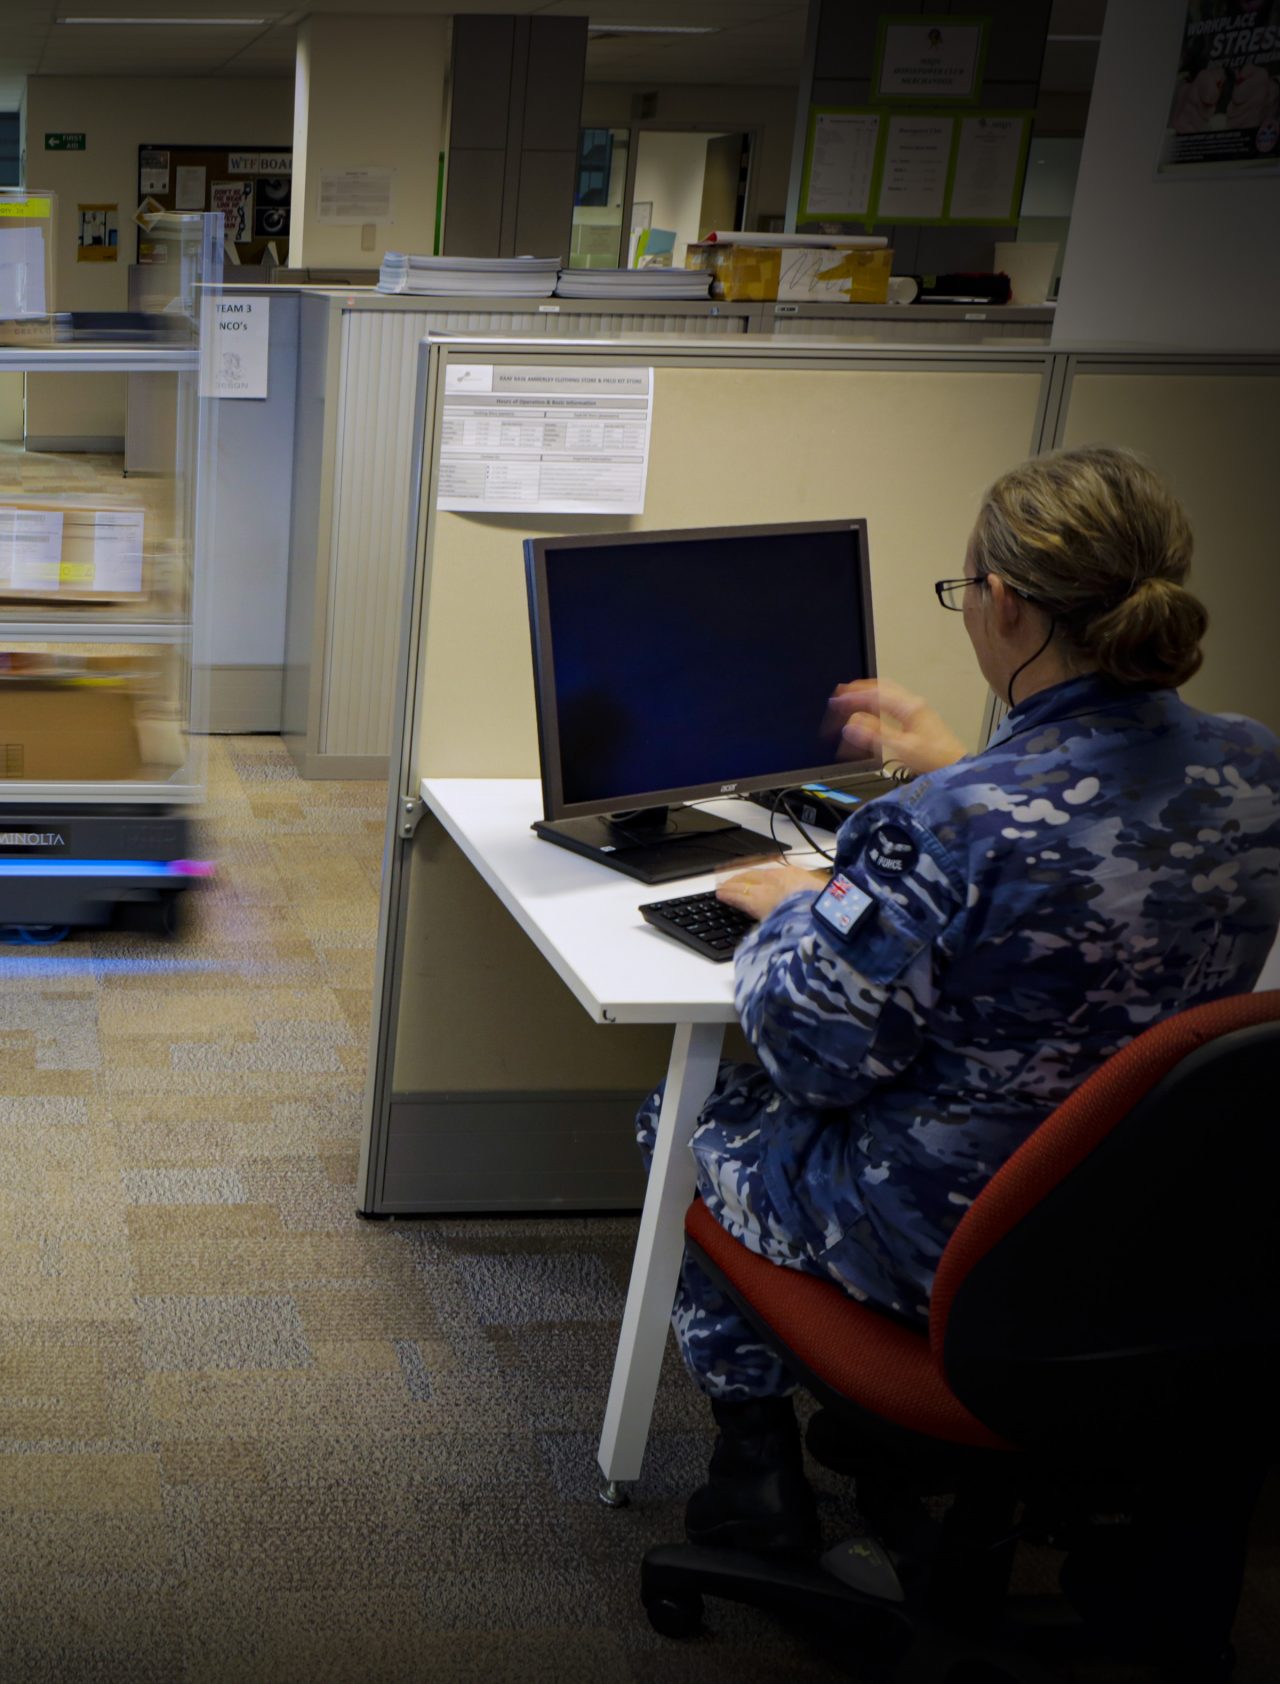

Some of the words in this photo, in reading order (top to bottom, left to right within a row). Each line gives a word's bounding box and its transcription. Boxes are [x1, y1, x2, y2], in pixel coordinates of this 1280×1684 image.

[1187, 12, 1258, 34] WORKPLACE
[1209, 25, 1280, 57] STRES
[231, 158, 257, 169] WTF
[216, 304, 243, 313] TEAM
[246, 304, 252, 313] 3
[219, 321, 248, 331] NCO's
[519, 399, 546, 407] Operation
[720, 784, 738, 793] acer
